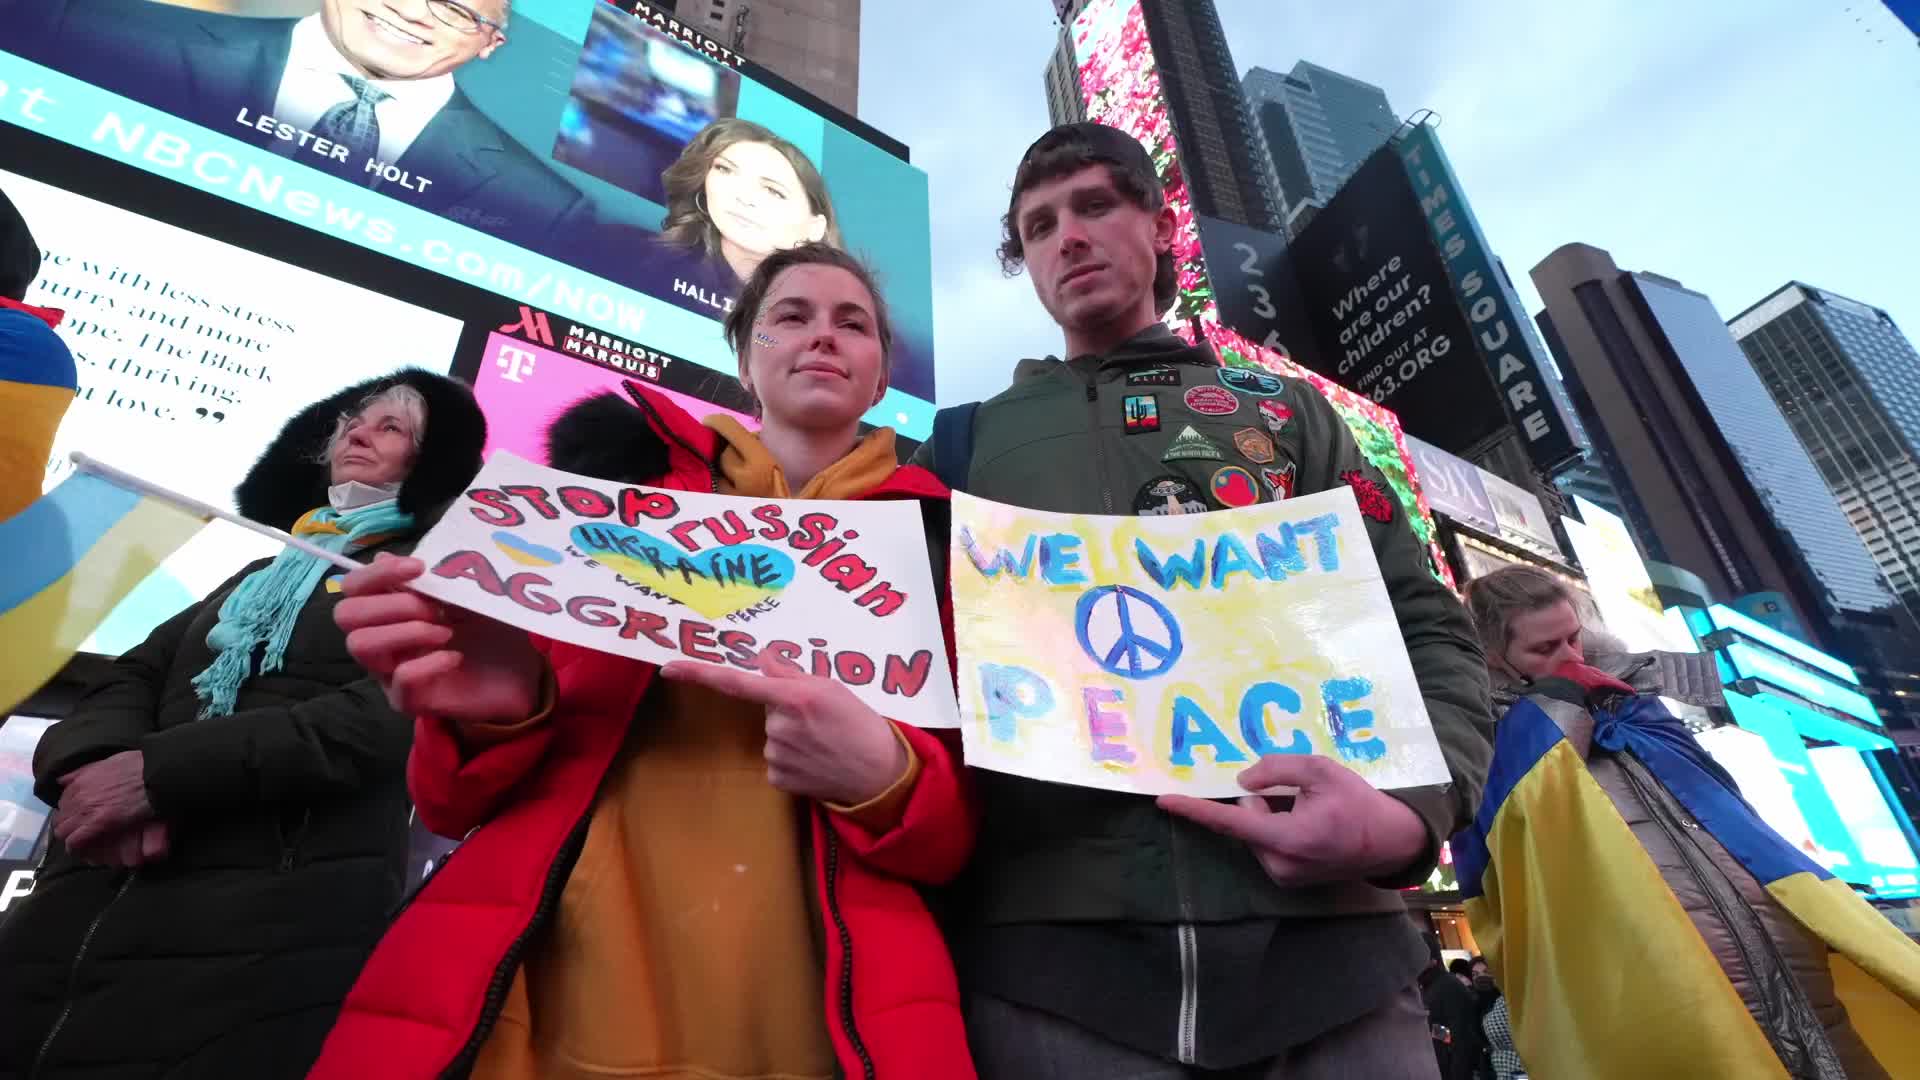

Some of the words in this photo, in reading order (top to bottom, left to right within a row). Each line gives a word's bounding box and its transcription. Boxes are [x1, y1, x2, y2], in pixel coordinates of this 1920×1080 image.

[635, 2, 746, 66] MARRIOTT
[236, 107, 349, 163] LESTER
[365, 158, 432, 193] HOLT
[92, 111, 647, 333] NBCNews.com/NOW
[82, 261, 151, 291] with
[160, 282, 210, 308] less
[221, 304, 296, 333] stress
[674, 278, 736, 313] HALLI
[1332, 256, 1401, 321] Where
[1340, 311, 1372, 345] are
[1375, 274, 1412, 312] our
[1404, 144, 1466, 259] TIMES
[1461, 270, 1551, 441] SQUARE
[67, 317, 123, 342] ope.
[139, 333, 192, 359] The
[200, 350, 272, 383] Black
[128, 304, 190, 331] and
[196, 324, 271, 353] more
[566, 338, 657, 378] MARQUIS
[569, 325, 672, 368] MARRIOTT
[1337, 284, 1432, 375] children?
[1357, 364, 1383, 390] FIND
[1384, 341, 1409, 367] OUT
[1413, 327, 1428, 346] AT
[107, 389, 176, 421] love.
[108, 357, 241, 404] thriving.
[468, 484, 679, 528] STOP
[578, 526, 782, 588] UKRAINE
[961, 525, 1088, 585] WE
[1134, 512, 1340, 592] WANT
[614, 573, 685, 606] WANT
[726, 595, 781, 624] PEACE
[978, 663, 1388, 767] PEACE
